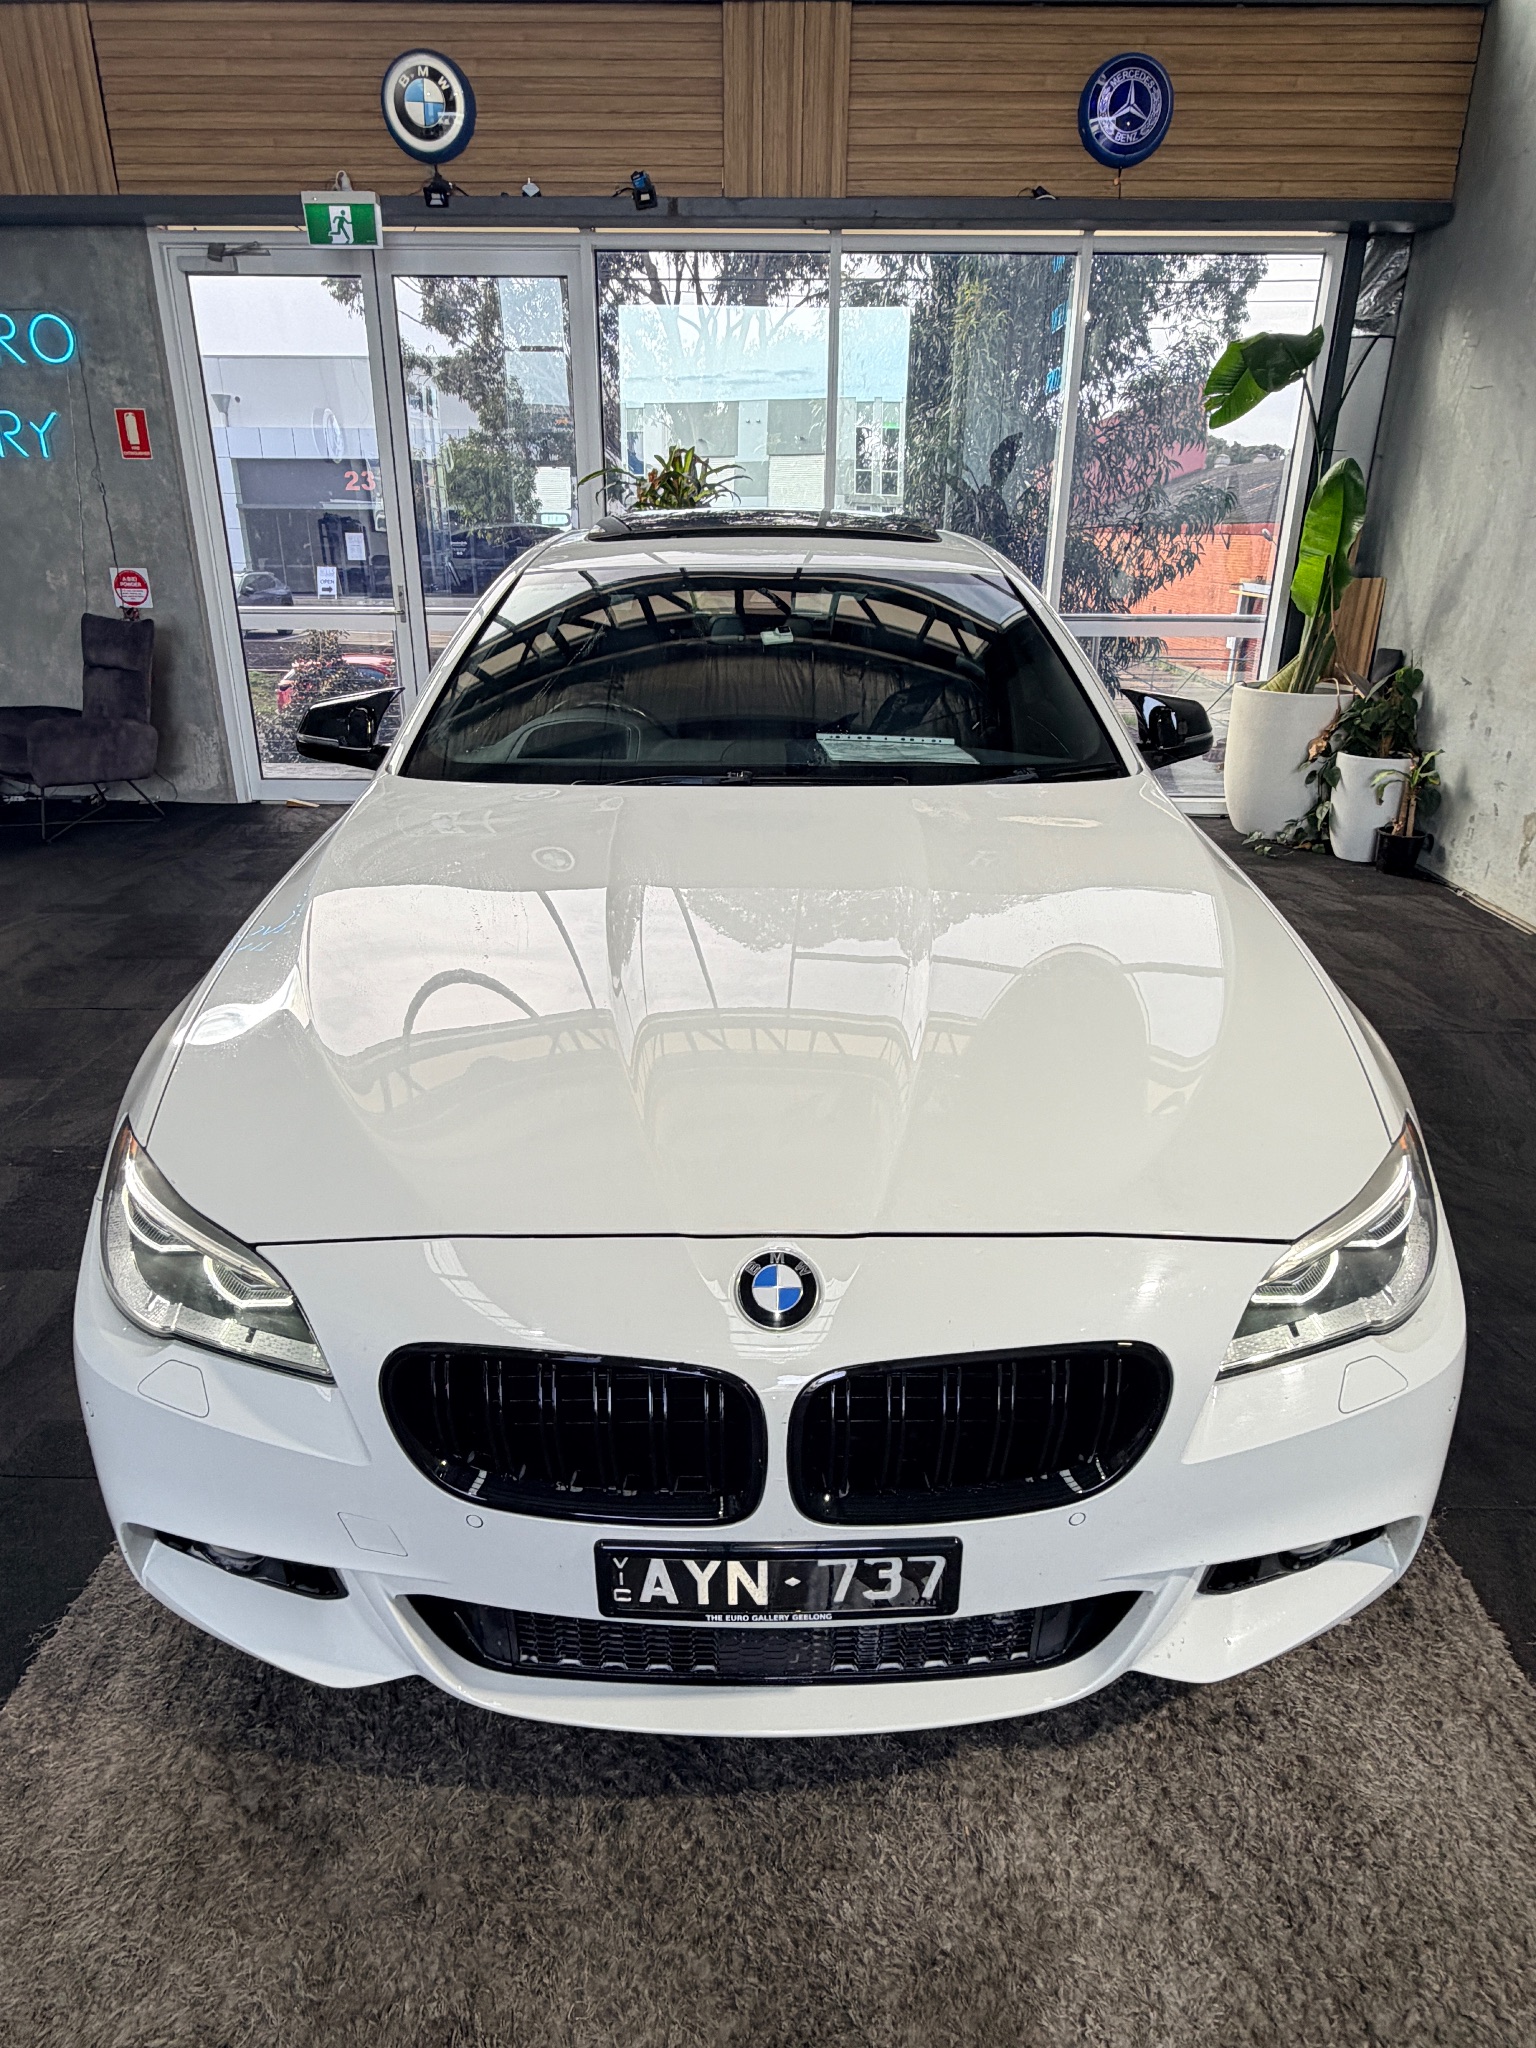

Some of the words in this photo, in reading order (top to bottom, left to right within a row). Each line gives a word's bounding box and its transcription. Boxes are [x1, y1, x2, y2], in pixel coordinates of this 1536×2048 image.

[399, 66, 450, 90] BMW
[1109, 69, 1156, 89] MERCEDES
[1114, 131, 1138, 143] BENZ
[344, 470, 376, 491] 23
[744, 1252, 812, 1276] BMW
[612, 1556, 632, 1603] VIC
[639, 1558, 769, 1606] AYN
[817, 1555, 947, 1603] 737
[705, 1614, 723, 1622] THE
[725, 1614, 750, 1622] EURO
[751, 1614, 790, 1622] GALLERY
[791, 1613, 833, 1621] GEELONG
